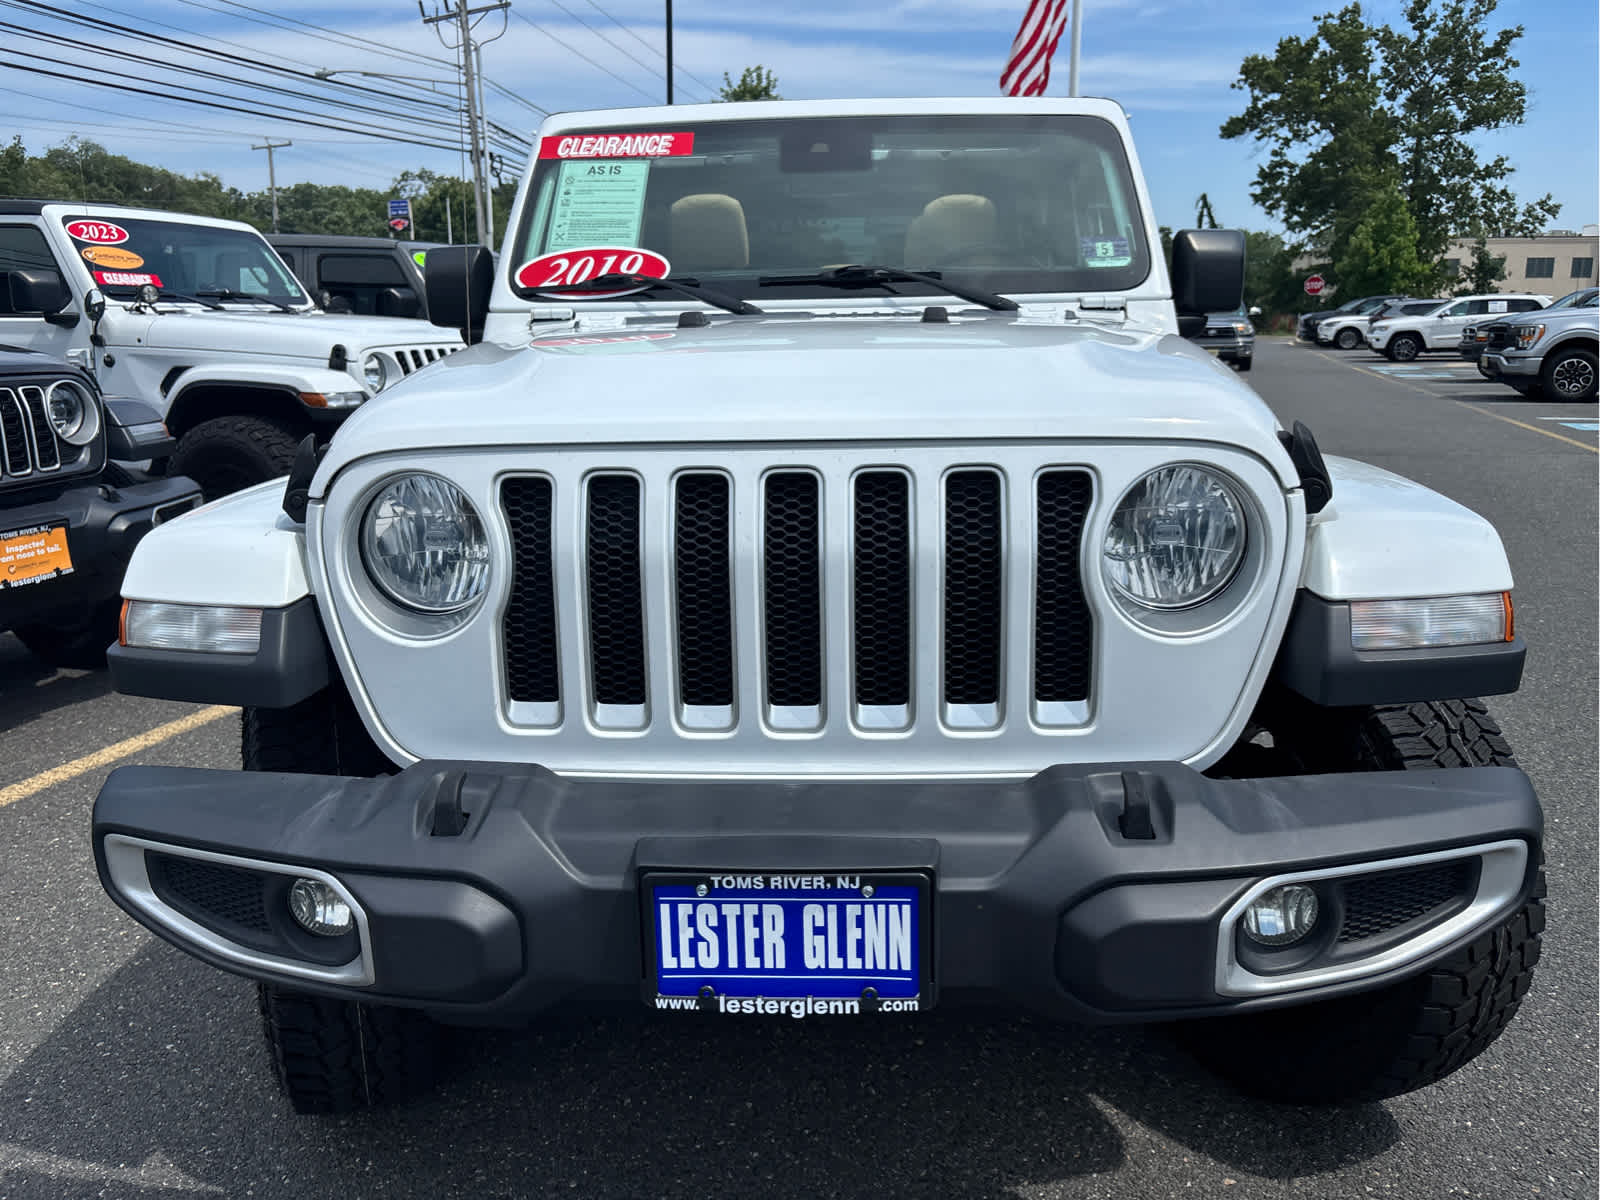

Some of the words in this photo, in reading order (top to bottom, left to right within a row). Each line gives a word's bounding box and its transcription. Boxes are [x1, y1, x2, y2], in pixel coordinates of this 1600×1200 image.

[557, 134, 674, 158] CLEARANCE
[587, 165, 605, 176] AS
[609, 165, 622, 175] IS
[78, 224, 118, 240] 2023
[1101, 243, 1109, 256] 5
[538, 253, 644, 287] 2019
[102, 272, 153, 287] CLEARANCE
[1305, 281, 1324, 289] STOP
[0, 531, 18, 539] TOMS
[6, 539, 45, 553] Inspected
[16, 550, 35, 560] nose
[710, 875, 765, 890] TOMS
[770, 875, 831, 890] RIVER,
[836, 876, 860, 889] NJ
[660, 903, 786, 969] LESTER
[802, 903, 911, 970] GLENN
[655, 998, 700, 1010] www.
[719, 996, 860, 1018] lesterglenn
[878, 998, 919, 1012] .com
